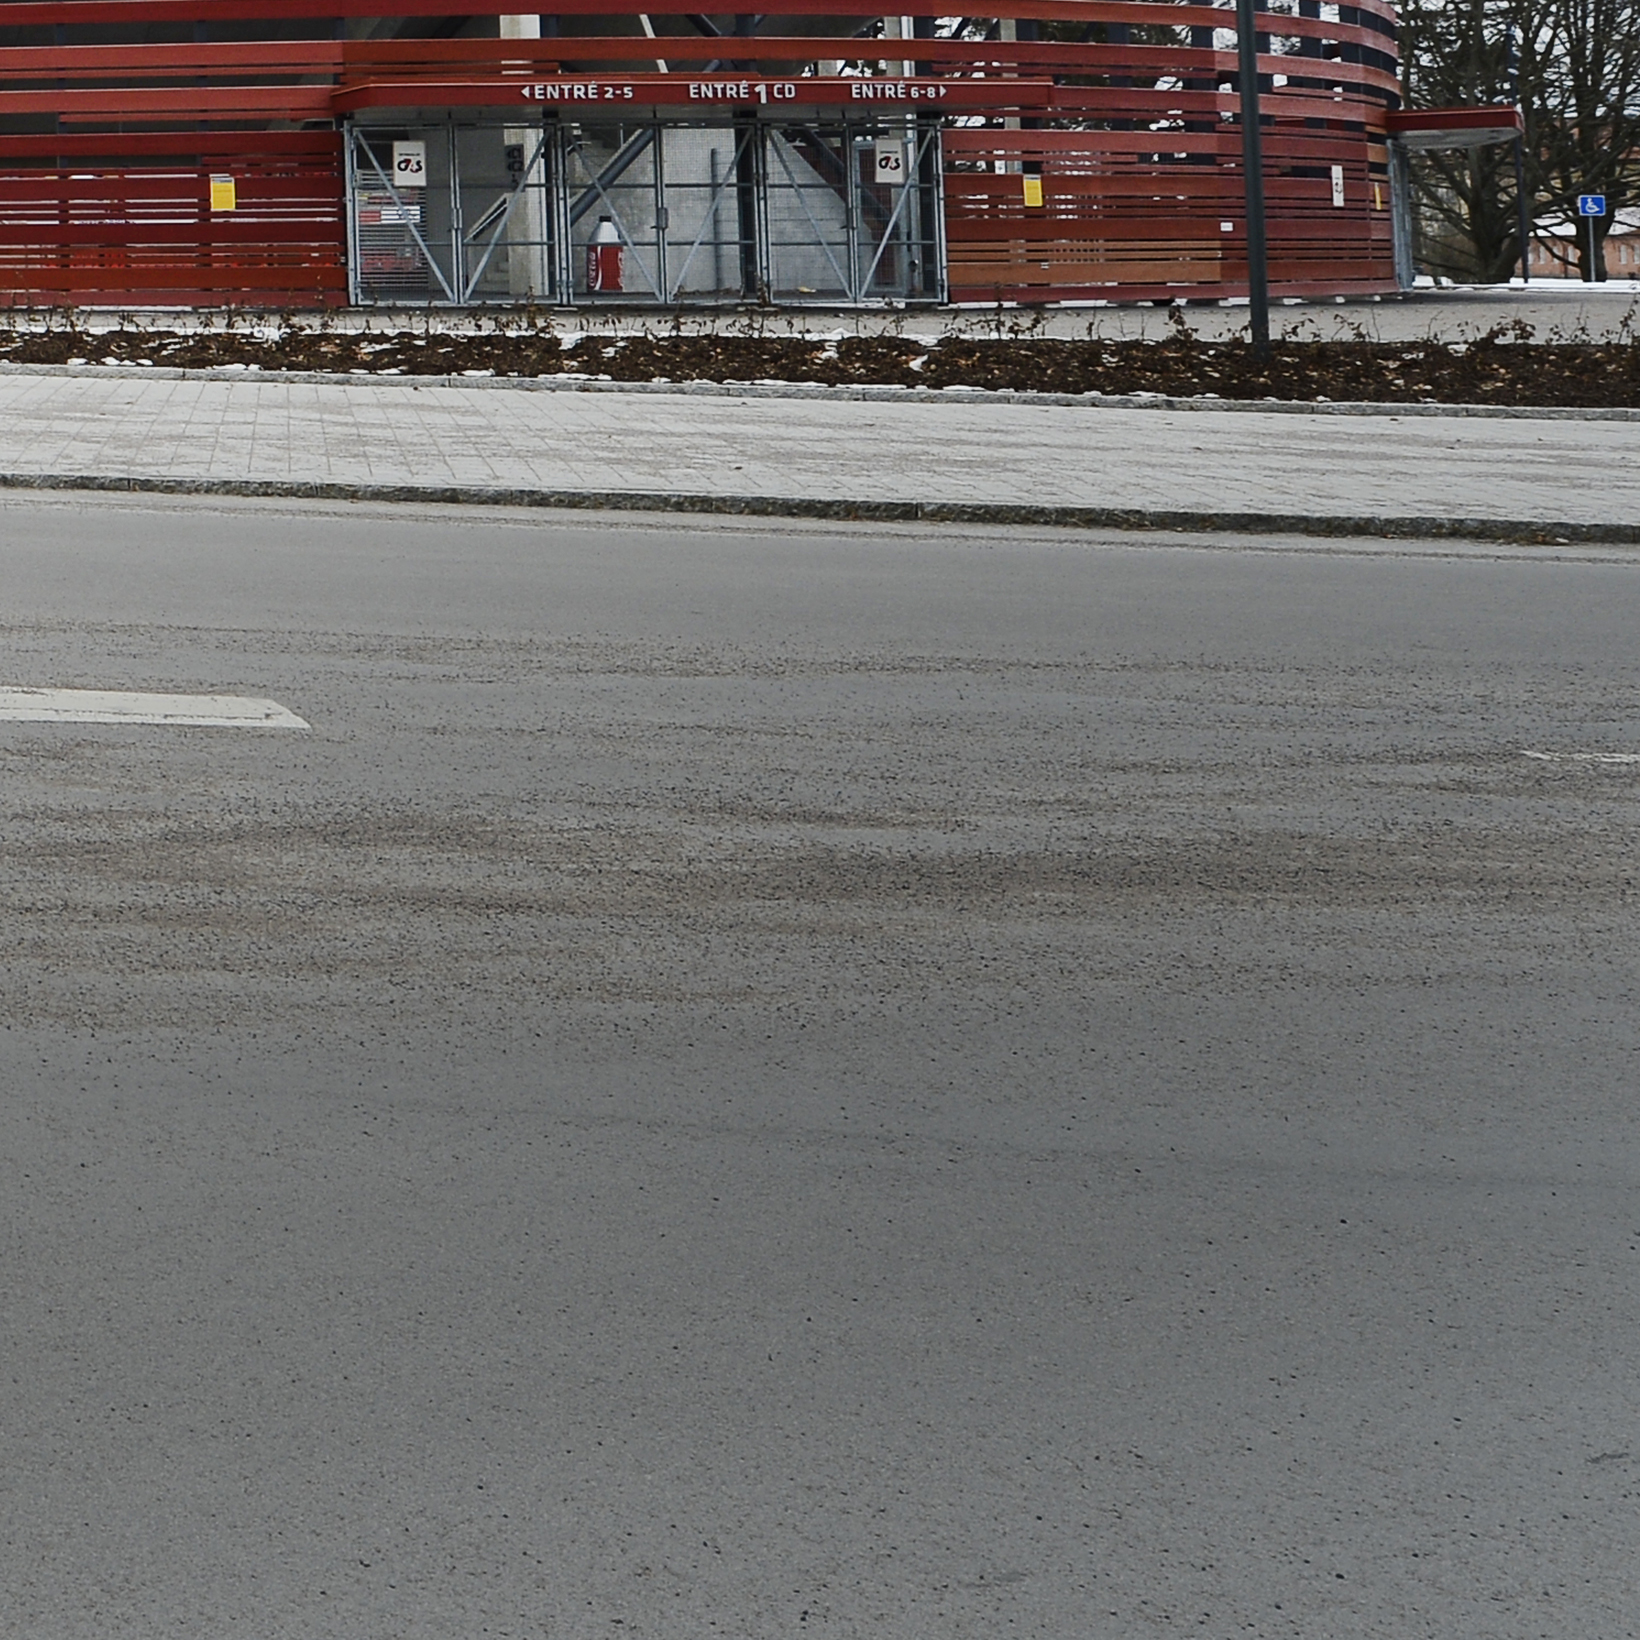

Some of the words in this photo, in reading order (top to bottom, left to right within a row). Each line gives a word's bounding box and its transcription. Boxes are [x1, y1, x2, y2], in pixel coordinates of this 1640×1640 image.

[534, 80, 598, 99] ENTRÉ
[604, 86, 633, 99] 2-5
[689, 80, 749, 99] ENTRÉ
[754, 83, 767, 104] 1
[773, 83, 795, 98] CD
[851, 80, 905, 98] ENTRÉ
[910, 87, 936, 98] 6-8
